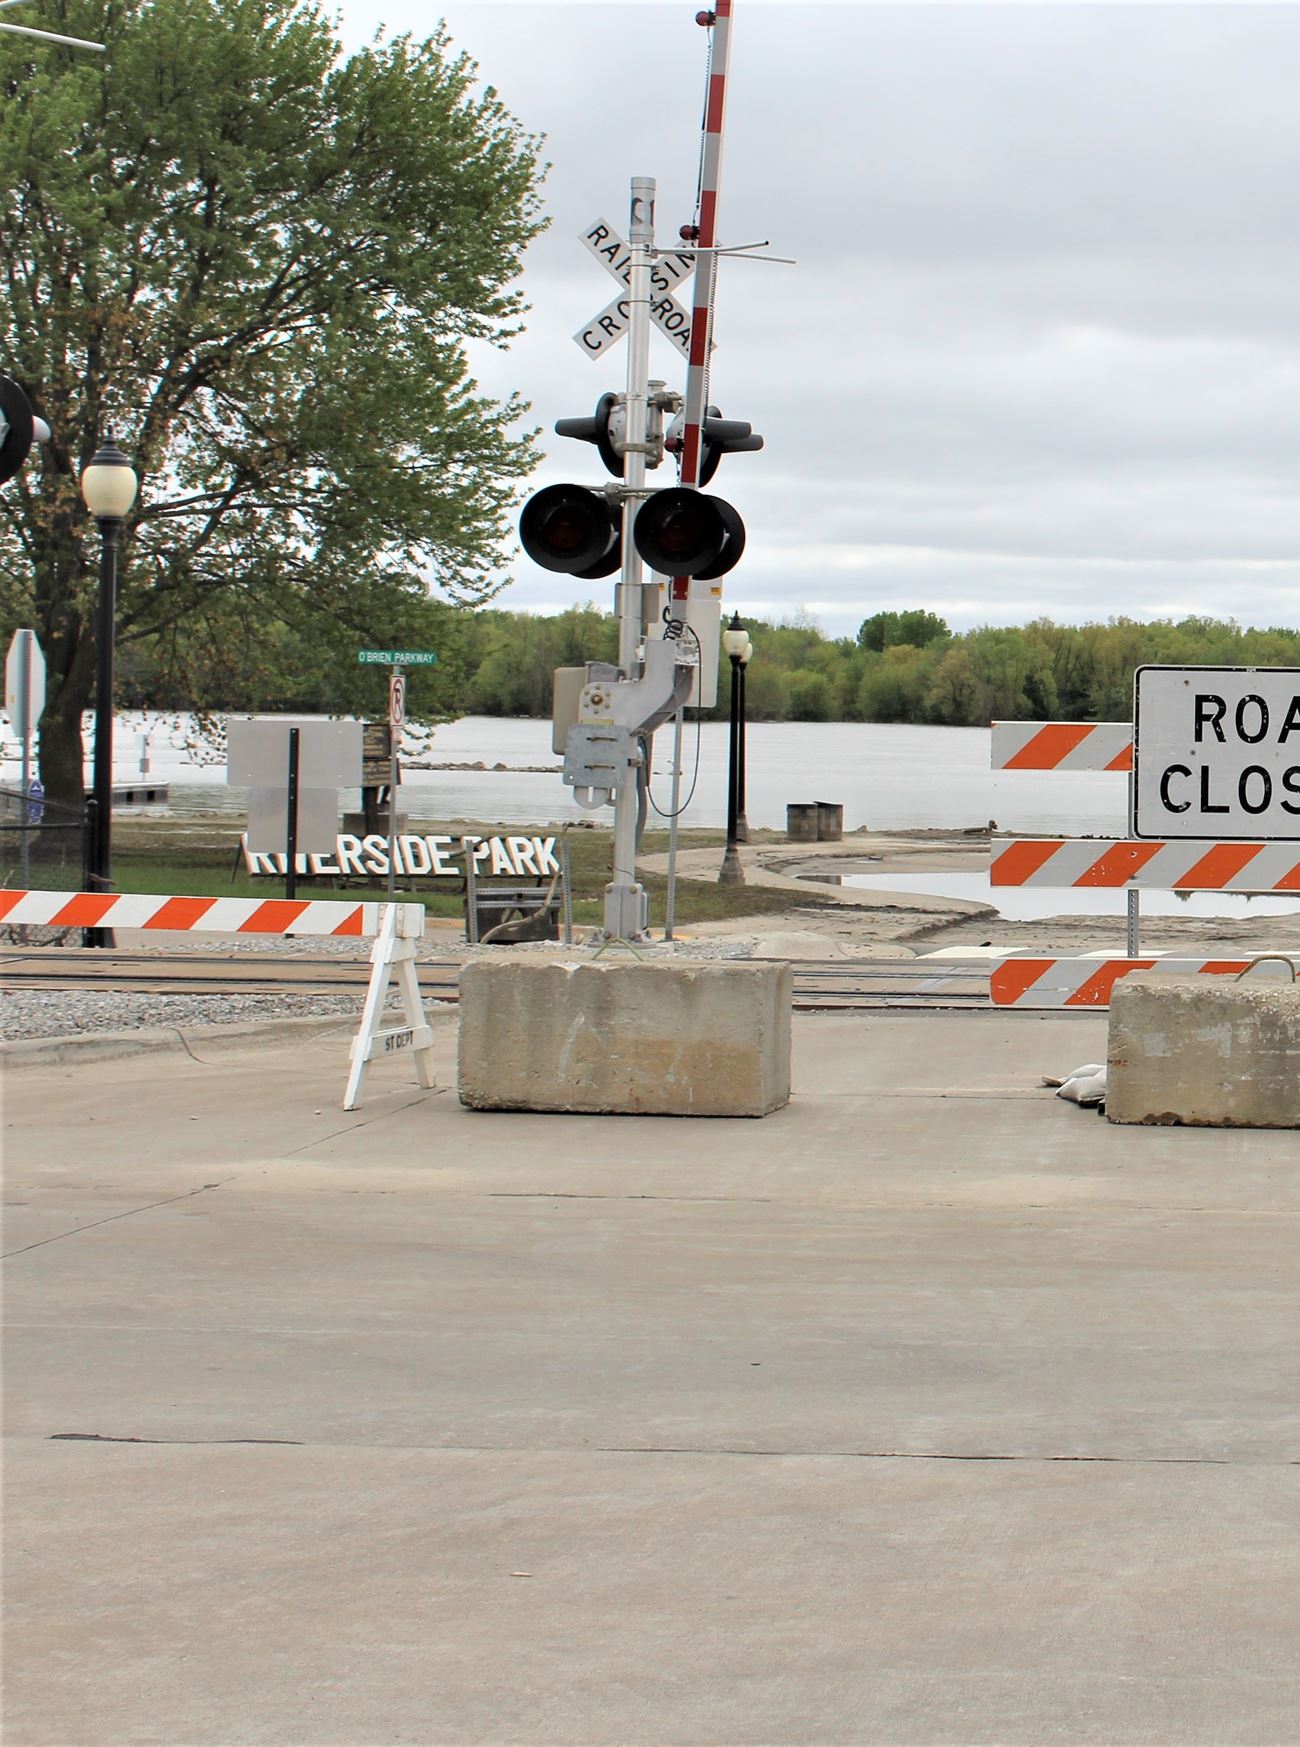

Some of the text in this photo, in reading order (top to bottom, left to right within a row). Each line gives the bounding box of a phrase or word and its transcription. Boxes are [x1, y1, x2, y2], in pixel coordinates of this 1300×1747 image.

[582, 245, 696, 350] CROSIN
[359, 652, 434, 664] O'BRIEN PARKWAY
[461, 835, 563, 876] PARK
[385, 1030, 414, 1052] ST DEPT
